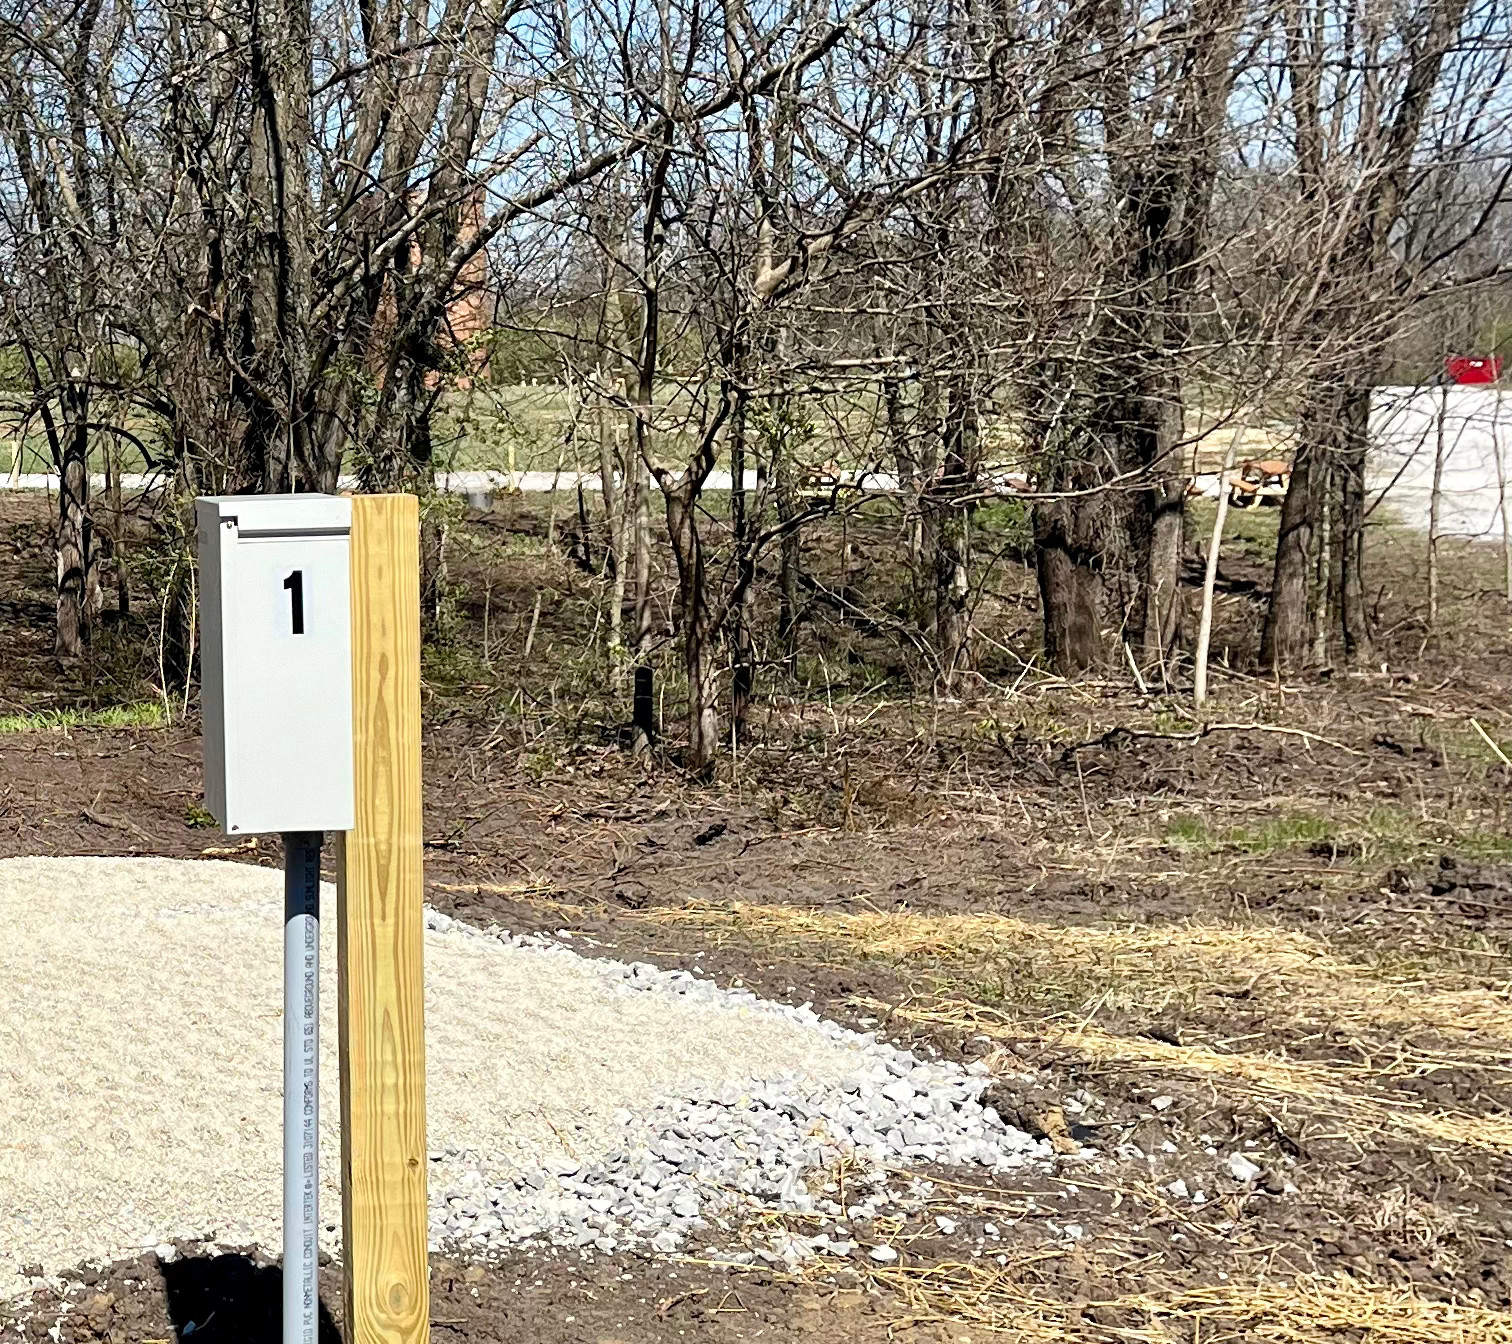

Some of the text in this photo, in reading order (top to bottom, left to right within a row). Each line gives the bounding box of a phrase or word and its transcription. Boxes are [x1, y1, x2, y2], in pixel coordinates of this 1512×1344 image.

[283, 570, 304, 635] 1
[304, 955, 314, 969] AND
[304, 972, 314, 1019] ABOVEGROUND
[304, 1039, 314, 1053] STD
[304, 1057, 313, 1066] UL
[304, 1068, 313, 1078] TO
[304, 1081, 313, 1116] CONFORMS
[304, 1152, 313, 1178] LISTED
[304, 1192, 313, 1224] INTERTEK
[304, 1229, 313, 1259] CONDUIT
[303, 1312, 313, 1326] PVC
